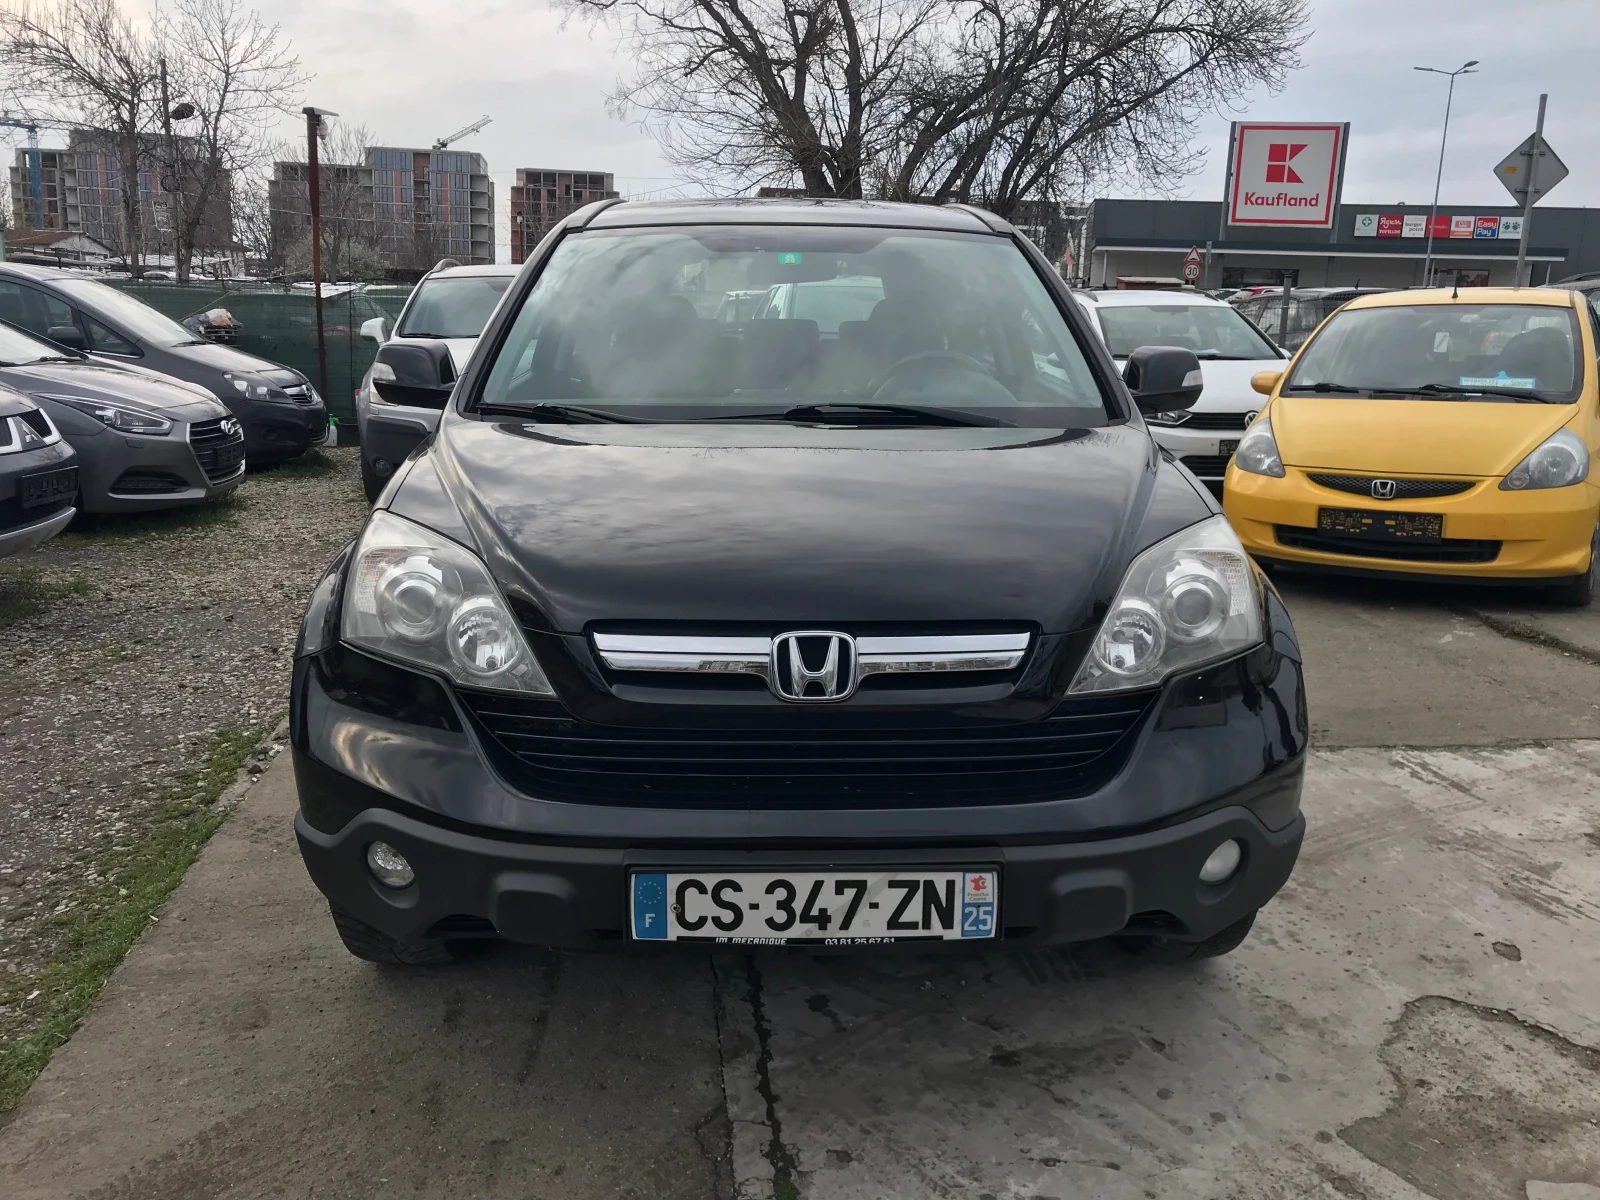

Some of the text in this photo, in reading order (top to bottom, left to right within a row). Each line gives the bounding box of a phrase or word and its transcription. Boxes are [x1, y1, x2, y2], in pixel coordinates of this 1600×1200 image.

[1244, 191, 1319, 207] Kaufland
[1477, 220, 1496, 229] Easy
[1186, 267, 1198, 276] 30
[675, 878, 956, 932] CS-347-ZN
[645, 913, 656, 928] F
[963, 906, 992, 931] 25
[825, 938, 838, 946] 03
